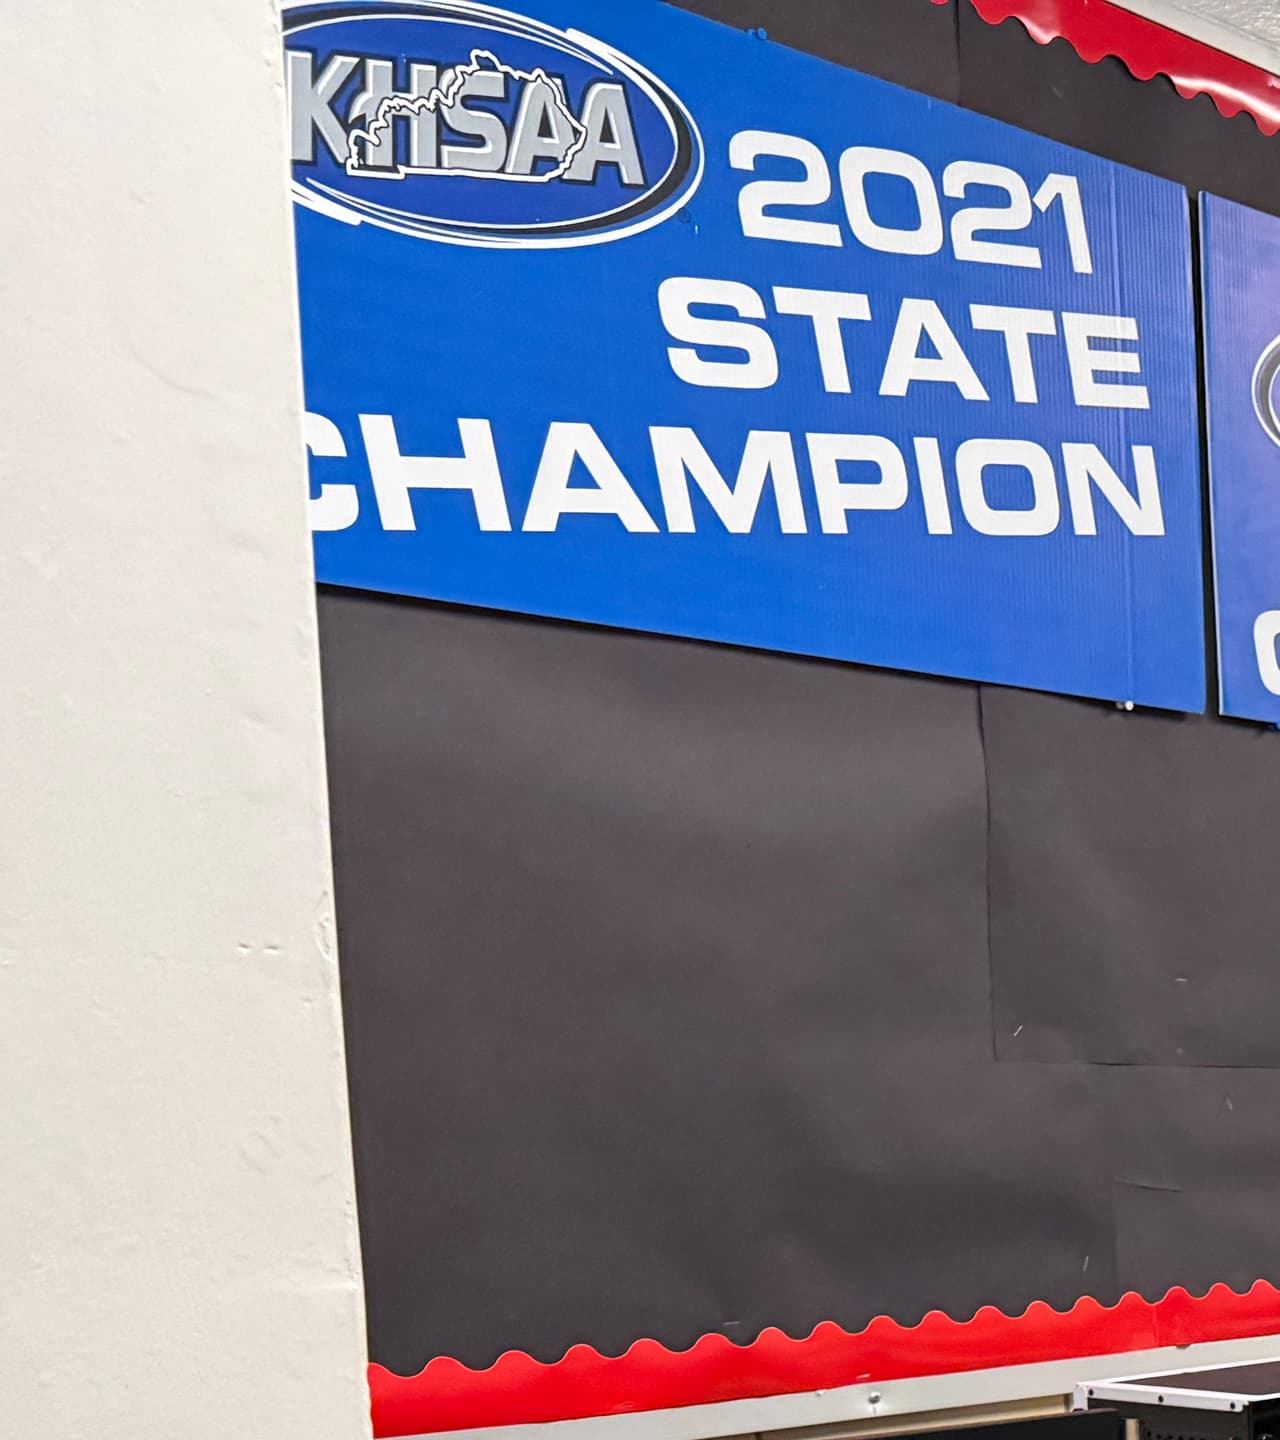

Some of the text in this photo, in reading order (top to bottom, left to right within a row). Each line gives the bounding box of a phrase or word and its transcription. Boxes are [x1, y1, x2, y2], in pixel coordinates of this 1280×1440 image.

[285, 51, 646, 186] KHSAA
[729, 130, 1093, 273] 2021
[658, 277, 1150, 409] STATE
